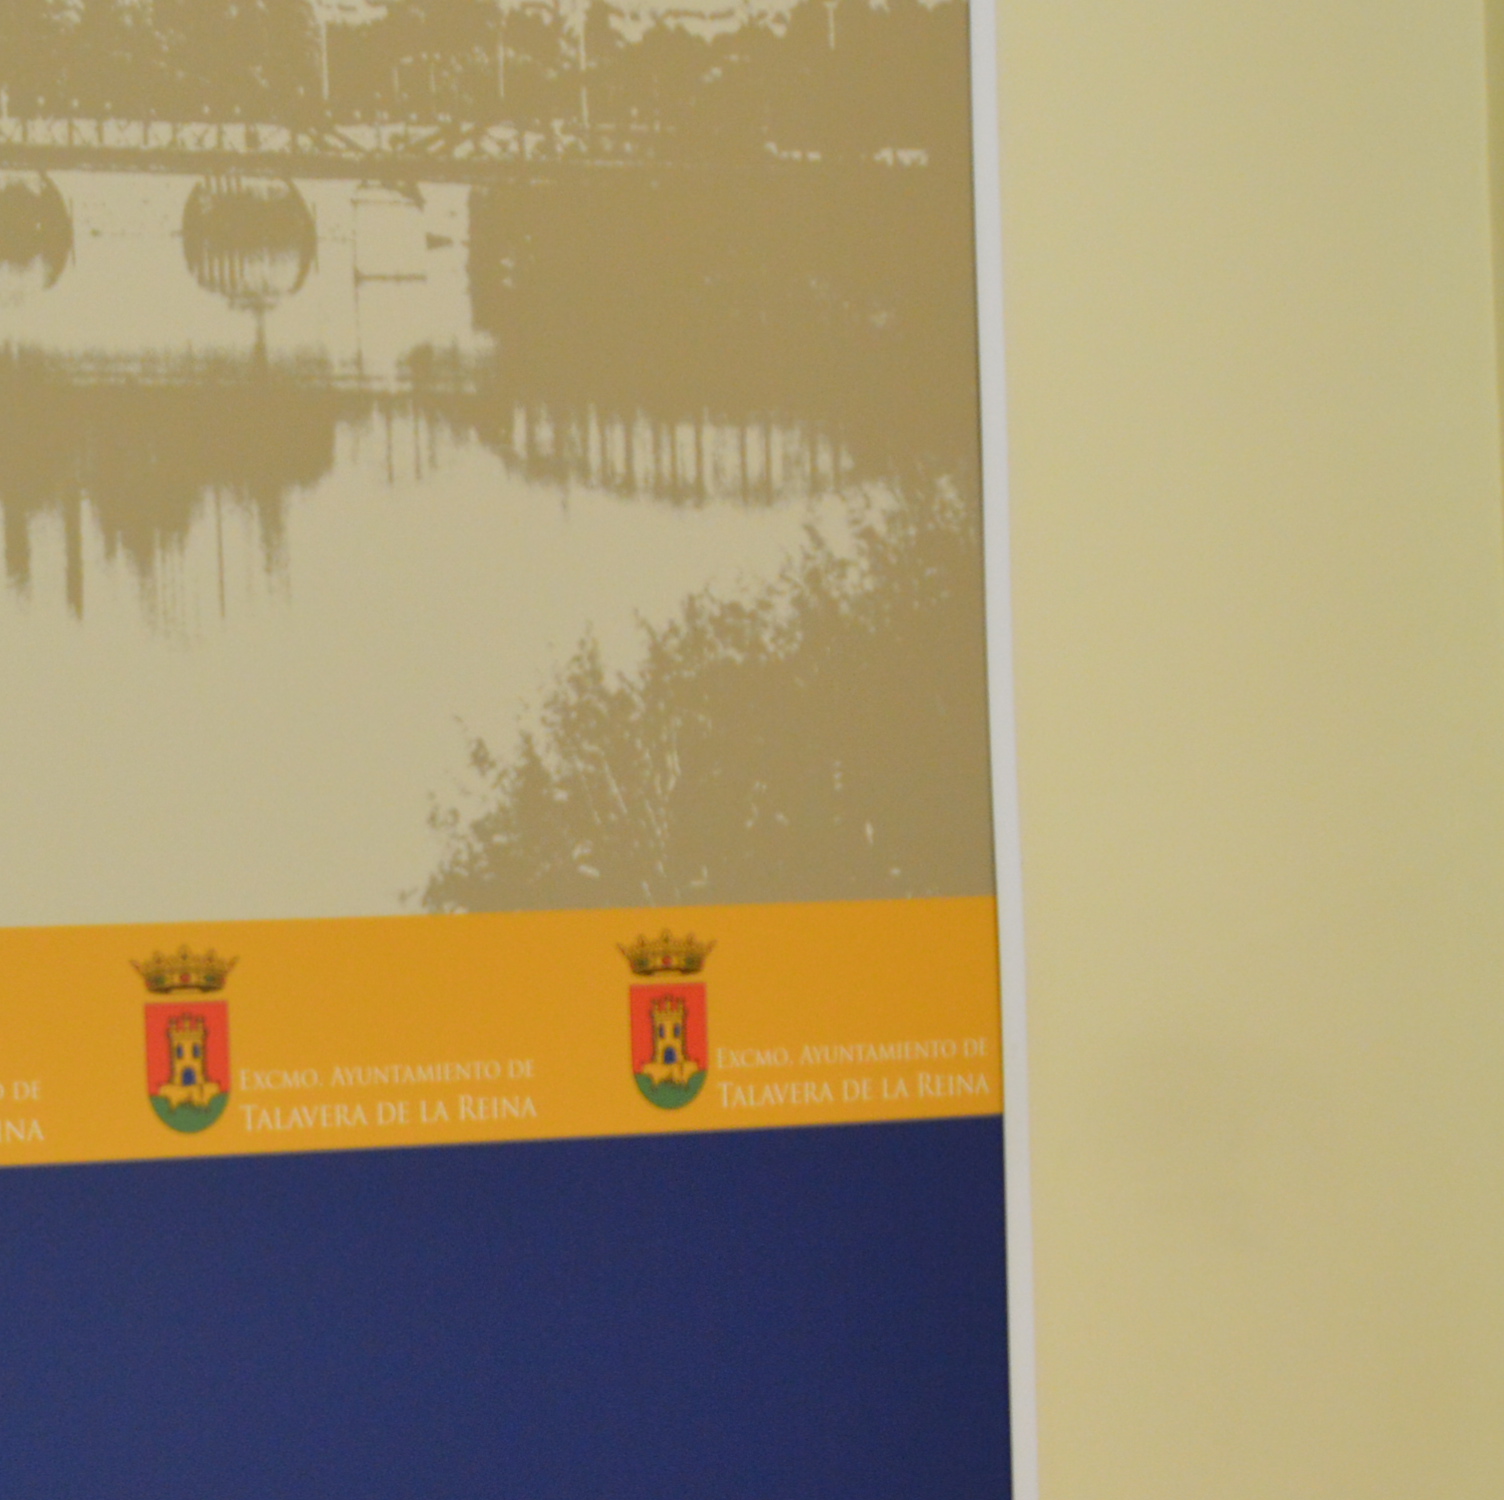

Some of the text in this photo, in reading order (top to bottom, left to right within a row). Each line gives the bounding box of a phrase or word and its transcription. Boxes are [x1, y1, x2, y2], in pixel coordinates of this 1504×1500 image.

[800, 1039, 958, 1066] AYUNTAMIENTO
[963, 1037, 990, 1058] DE
[330, 1059, 502, 1088] AYUNTAMIENTO
[507, 1058, 536, 1080] DE
[13, 1079, 41, 1101] DE
[716, 1072, 992, 1109] TALAVERA DE LA REINA
[239, 1094, 539, 1132] TALAVERA DE LA REINA
